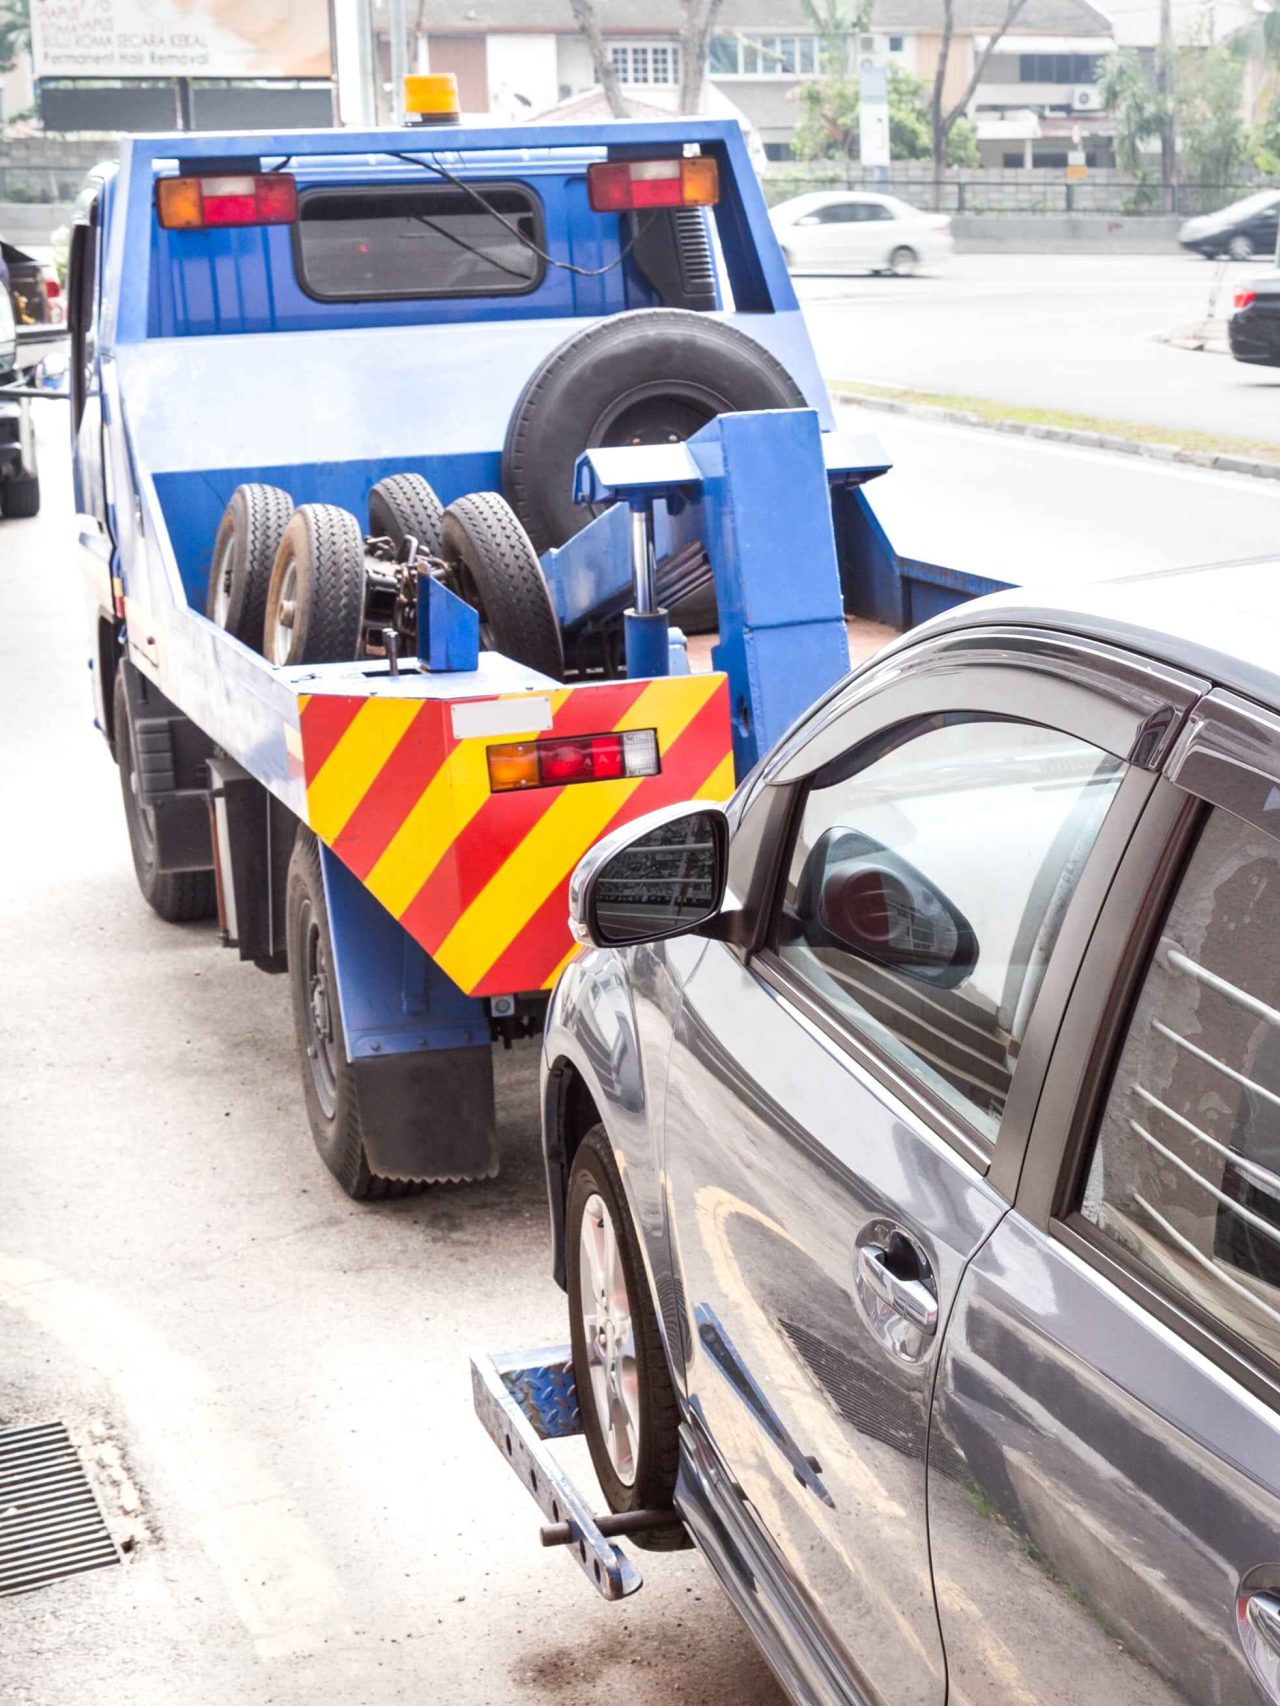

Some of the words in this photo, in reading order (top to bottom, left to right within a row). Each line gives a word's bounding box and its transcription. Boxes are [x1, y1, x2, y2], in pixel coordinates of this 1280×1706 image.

[117, 33, 166, 48] SECARA
[44, 51, 114, 65] Permanent
[119, 52, 144, 65] Hair
[150, 51, 209, 65] Removal
